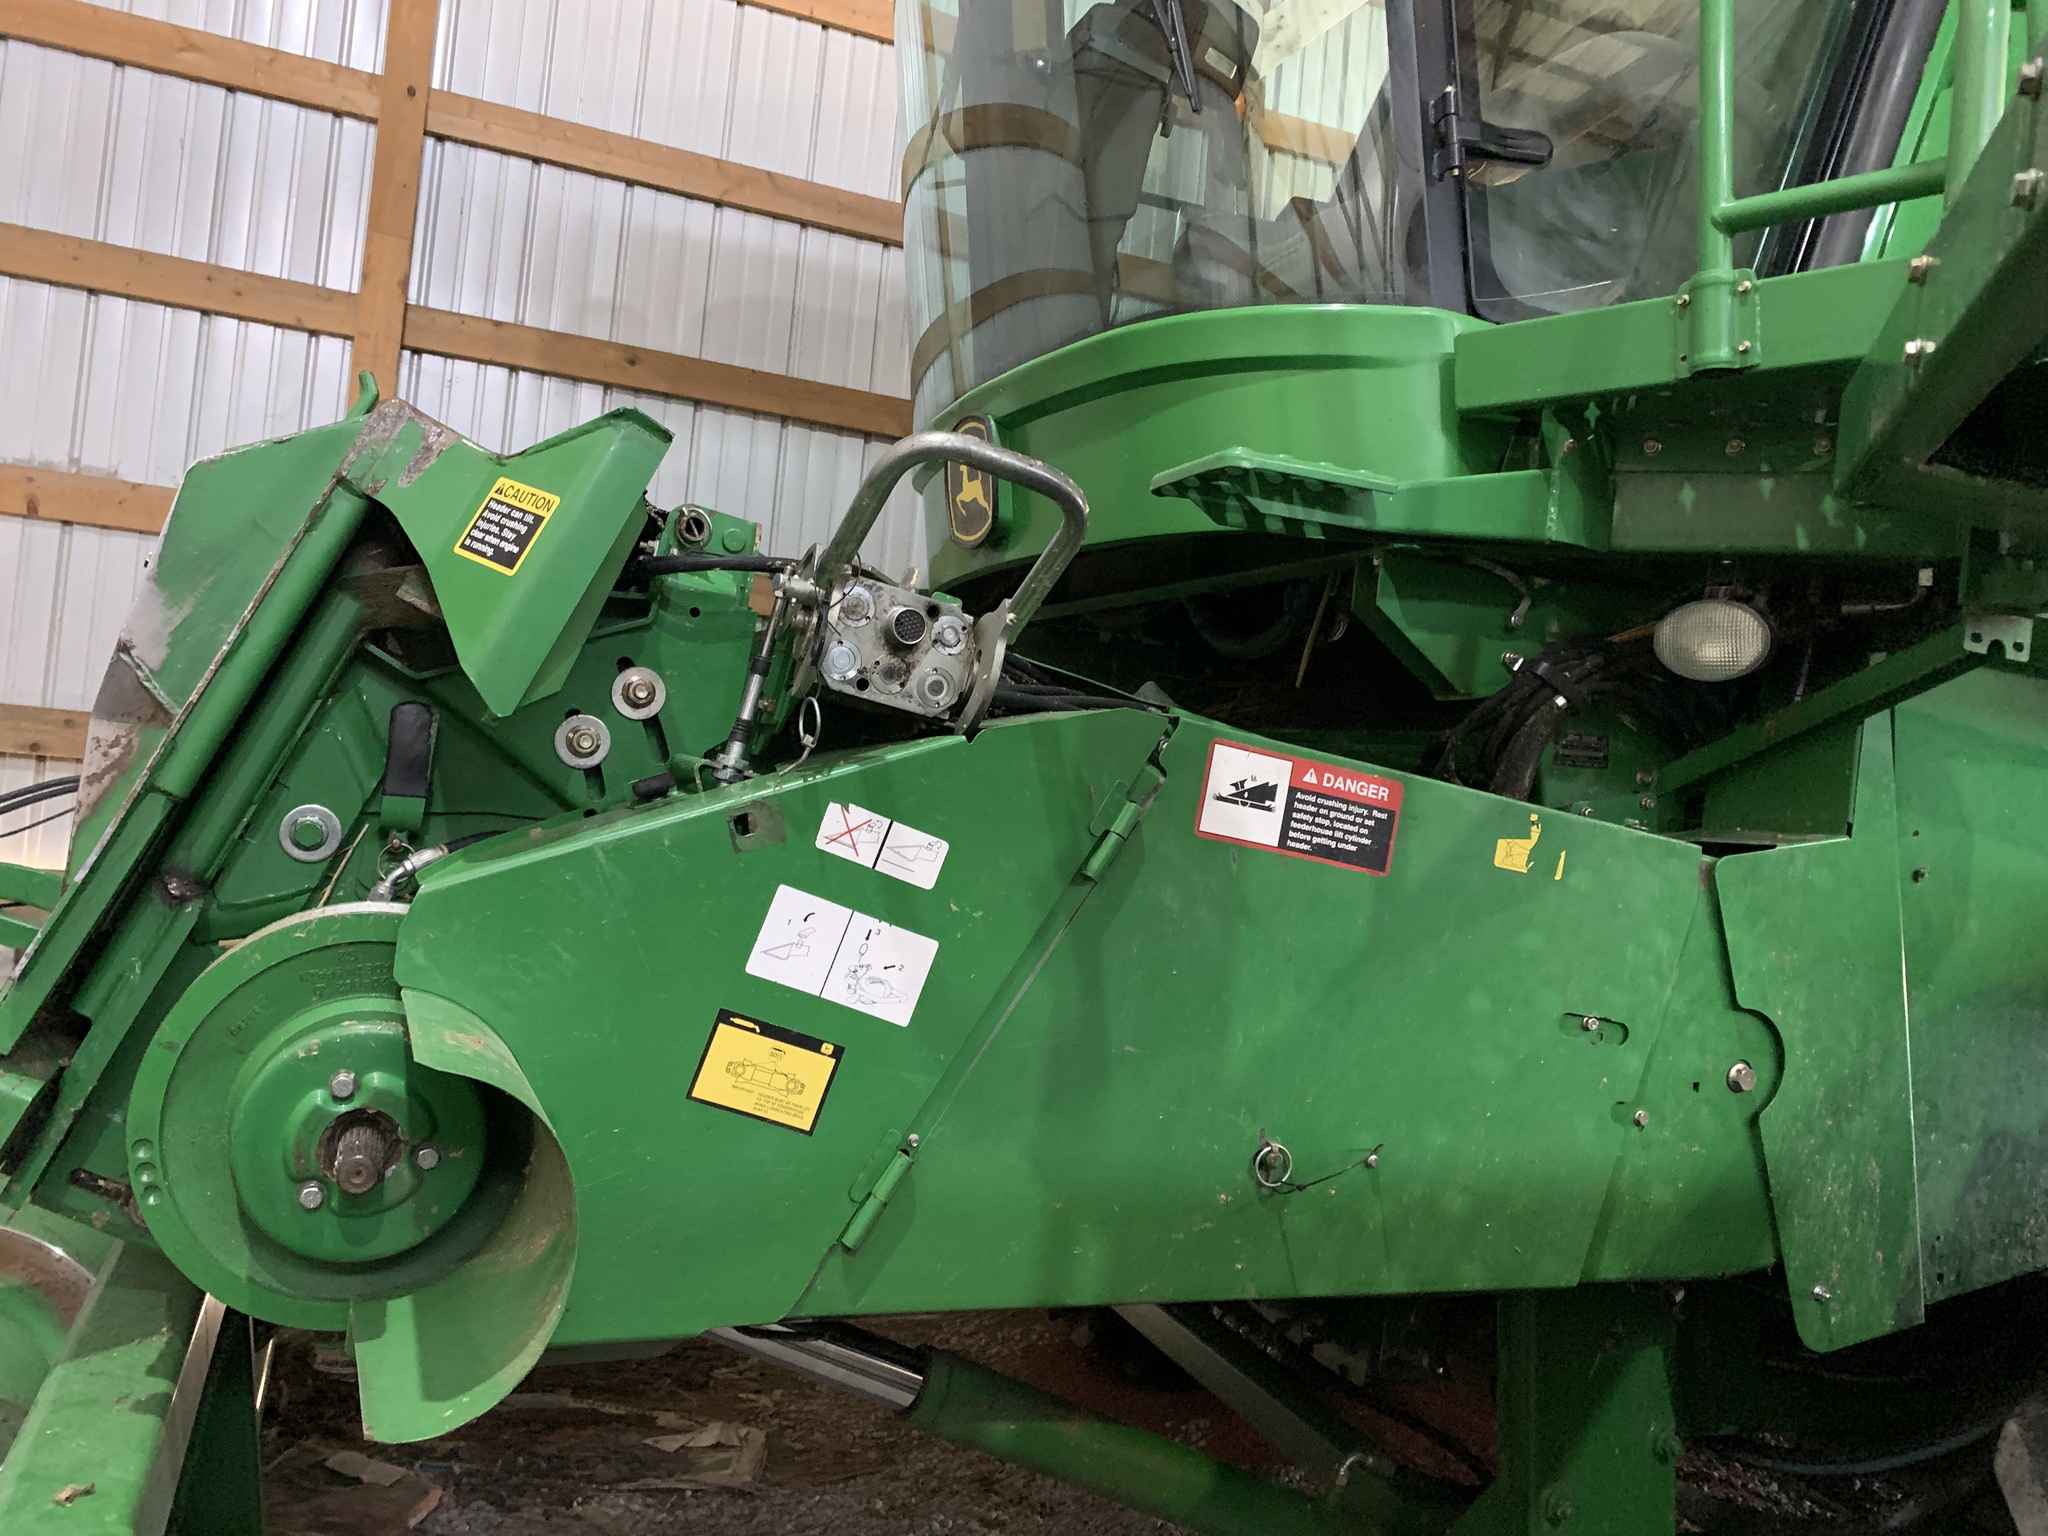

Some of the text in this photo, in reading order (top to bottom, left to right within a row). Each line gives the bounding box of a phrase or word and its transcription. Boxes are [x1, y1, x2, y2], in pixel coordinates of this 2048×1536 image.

[487, 499, 535, 525] Header can tilt.
[503, 485, 555, 513] CAUTION
[481, 509, 528, 535] Avoid crushing
[501, 527, 517, 542] Stay
[464, 537, 495, 556] is running.
[470, 528, 520, 554] clear when engine
[1322, 773, 1390, 802] DANGER
[1294, 801, 1375, 827] header on ground or set
[1295, 791, 1389, 820] Avoid crushing injury. Rest
[1290, 820, 1373, 846] feederhouse lift cylinder
[1292, 812, 1314, 824] safety
[1314, 816, 1332, 827] stop,
[1333, 820, 1359, 833] located
[1286, 839, 1313, 852] header.
[1288, 830, 1358, 852] before getting under
